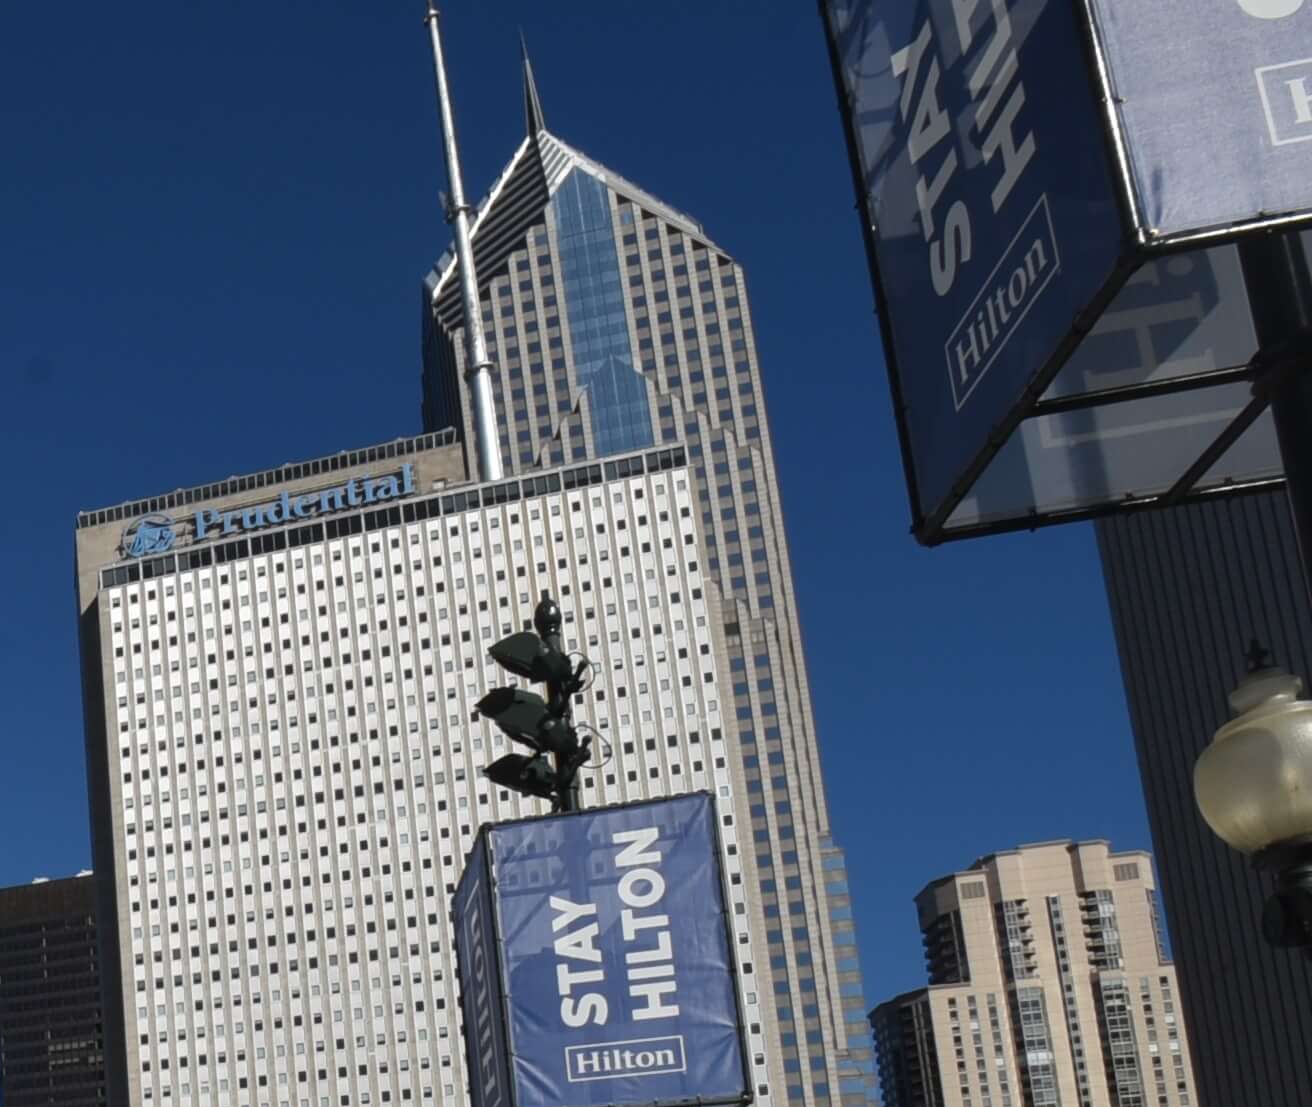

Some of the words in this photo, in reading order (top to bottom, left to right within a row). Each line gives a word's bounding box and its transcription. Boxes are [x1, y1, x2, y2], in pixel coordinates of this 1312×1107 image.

[891, 20, 973, 297] STAY
[954, 238, 1048, 384] Hilton
[192, 463, 417, 542] Prudential
[549, 895, 609, 1028] STAY
[612, 826, 680, 1021] HILTON
[469, 905, 497, 1098] Hilton
[576, 1048, 675, 1074] Hilton
